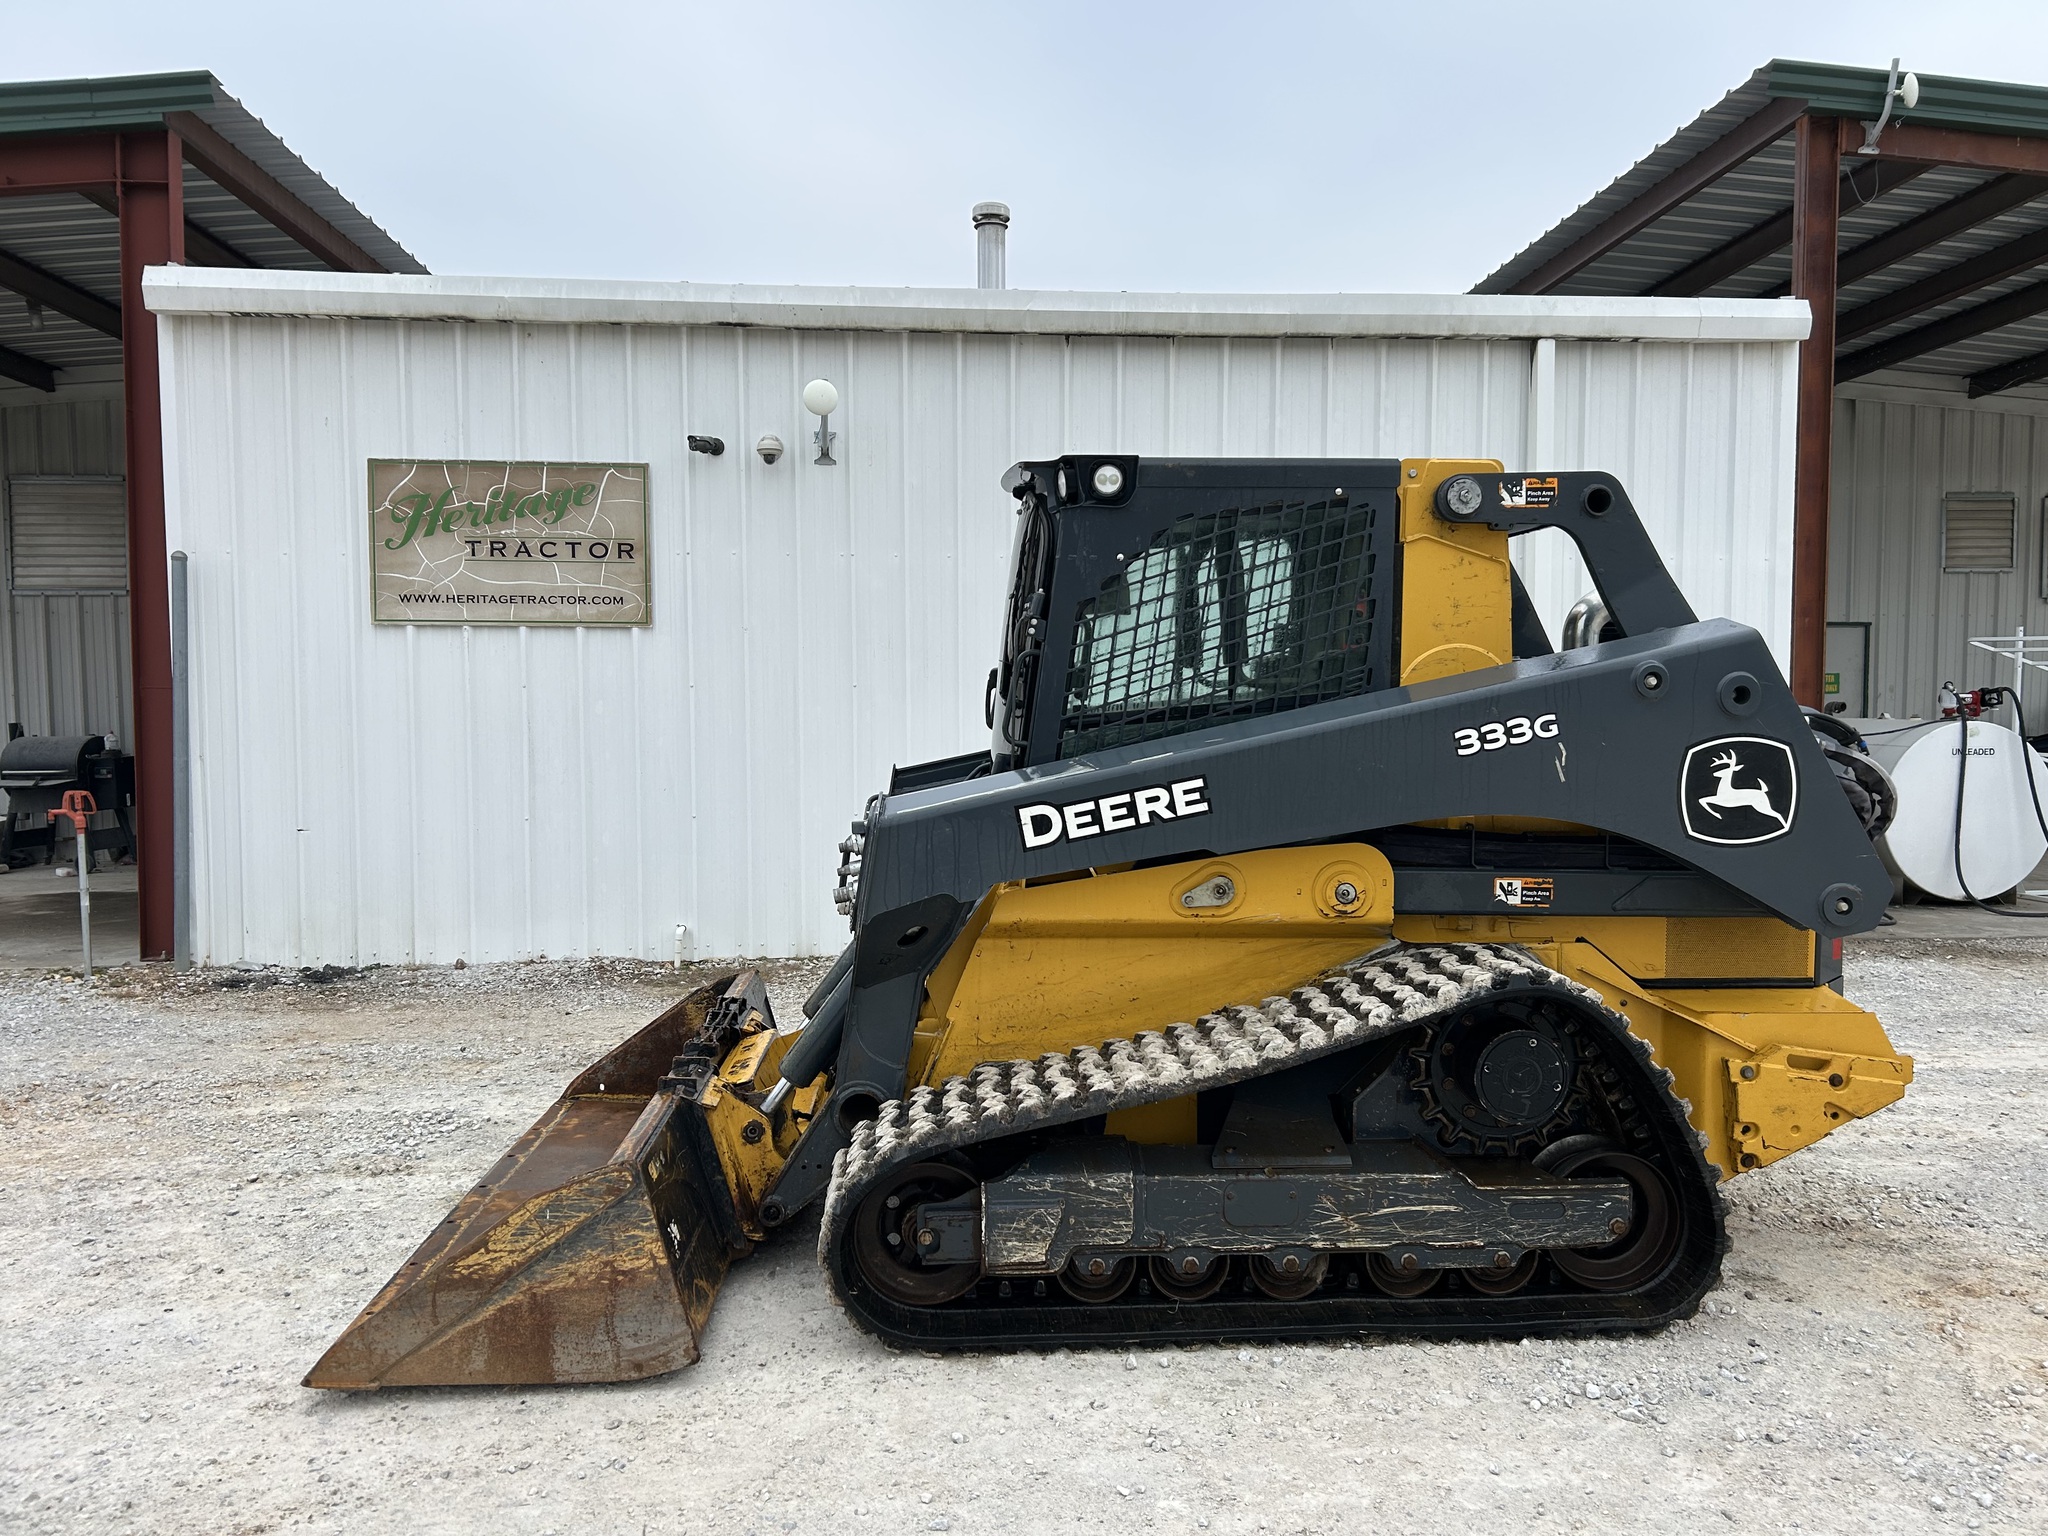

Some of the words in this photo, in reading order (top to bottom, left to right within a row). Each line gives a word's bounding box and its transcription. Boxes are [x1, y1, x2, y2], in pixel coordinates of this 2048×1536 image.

[384, 482, 596, 550] Heritage
[464, 539, 635, 560] TRACTOR
[398, 594, 624, 606] WWW.HERITAGETRACTOR.COM
[1454, 713, 1560, 756] 333G
[1951, 748, 1995, 756] UNEADED
[1018, 778, 1209, 848] DEERE
